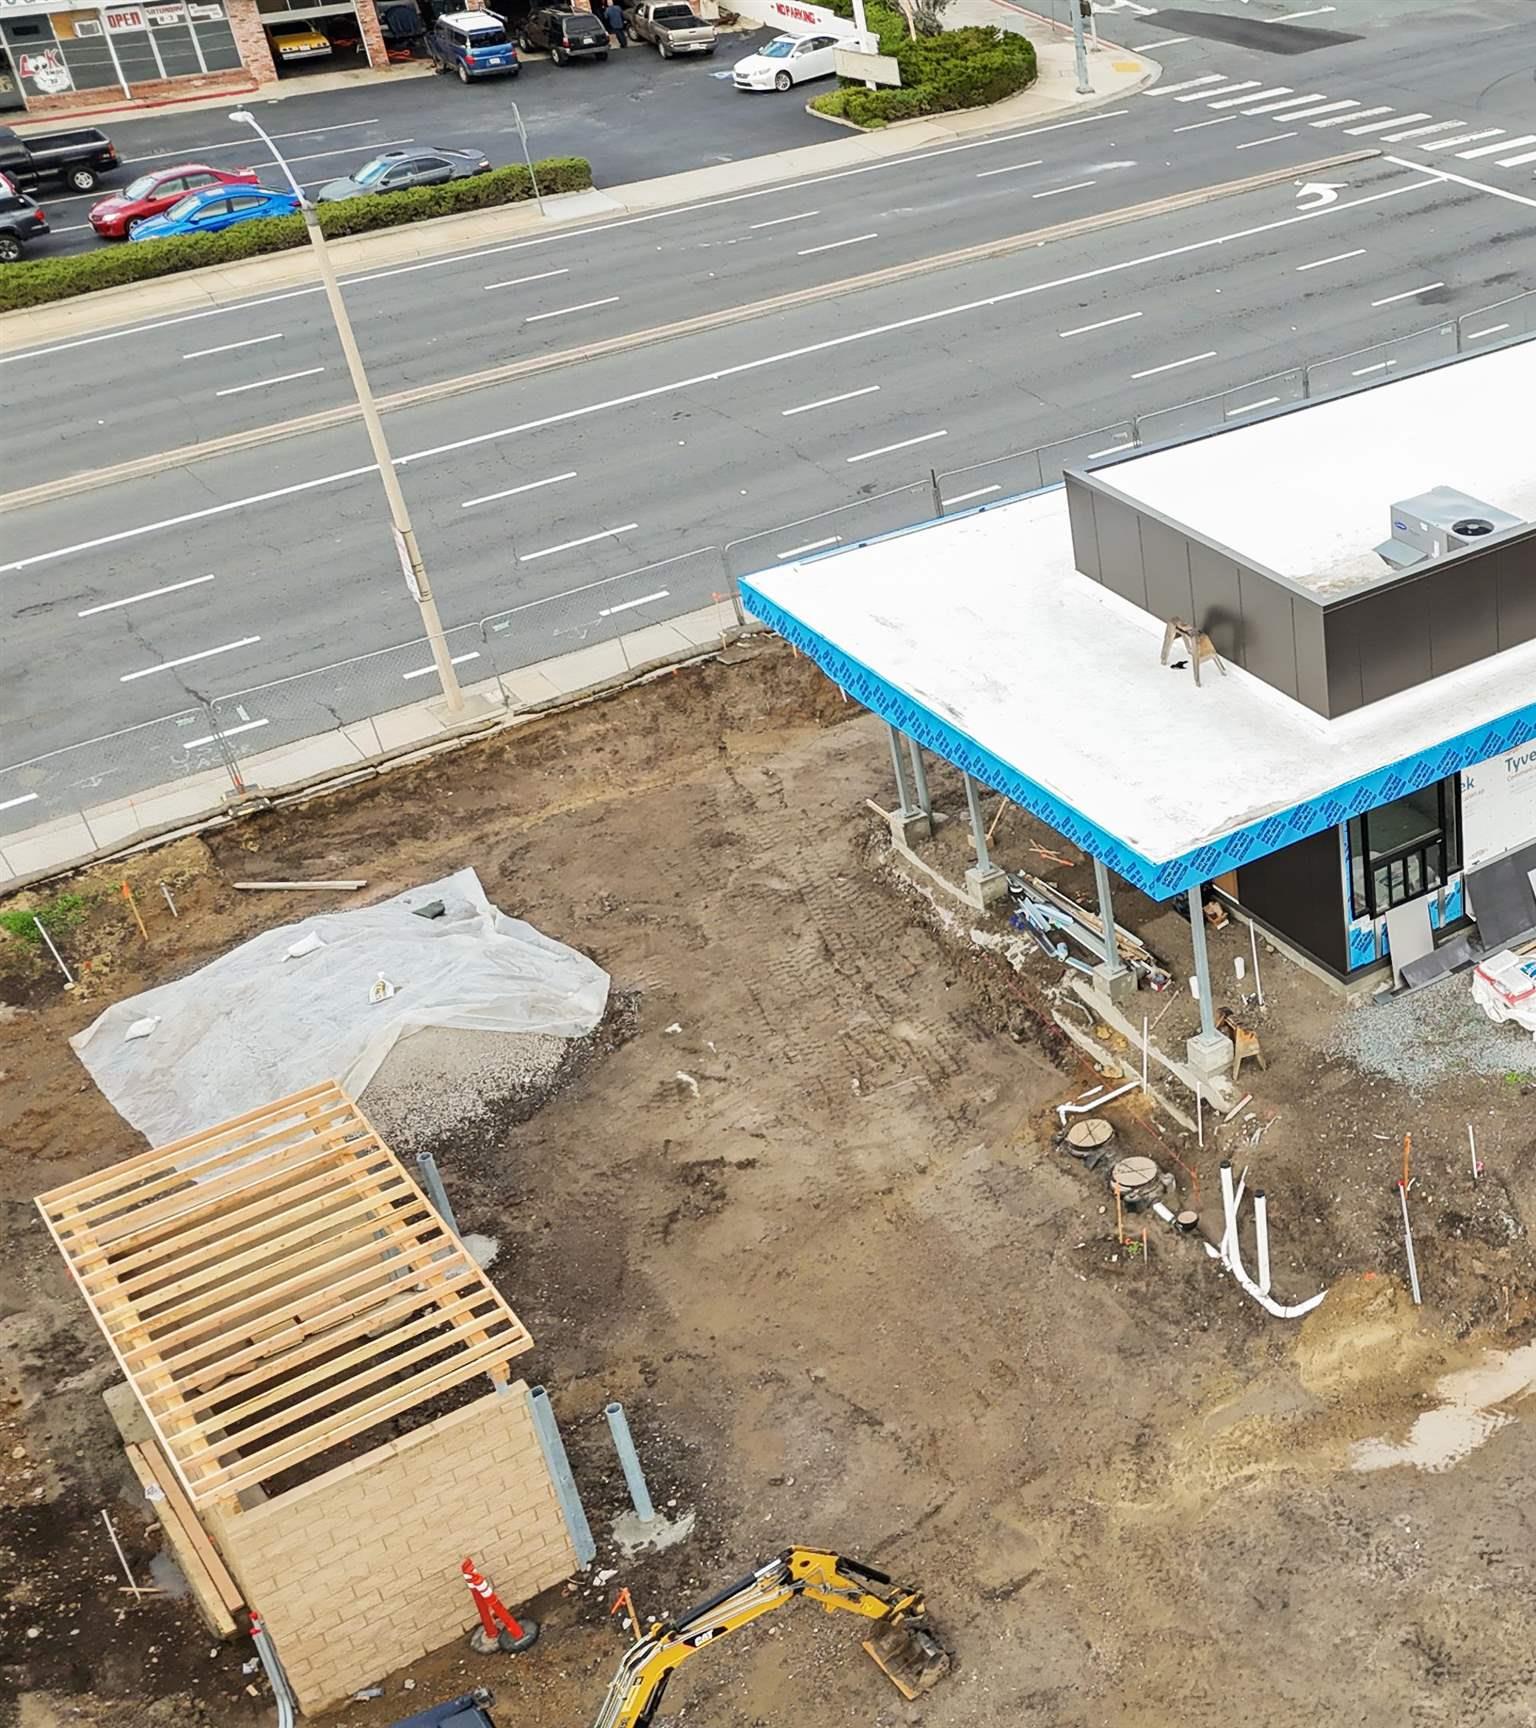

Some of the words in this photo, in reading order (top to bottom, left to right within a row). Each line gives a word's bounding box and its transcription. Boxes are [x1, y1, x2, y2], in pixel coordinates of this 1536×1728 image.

[107, 11, 142, 28] OPEN
[785, 5, 816, 24] PARKING
[694, 1629, 713, 1647] CAT
